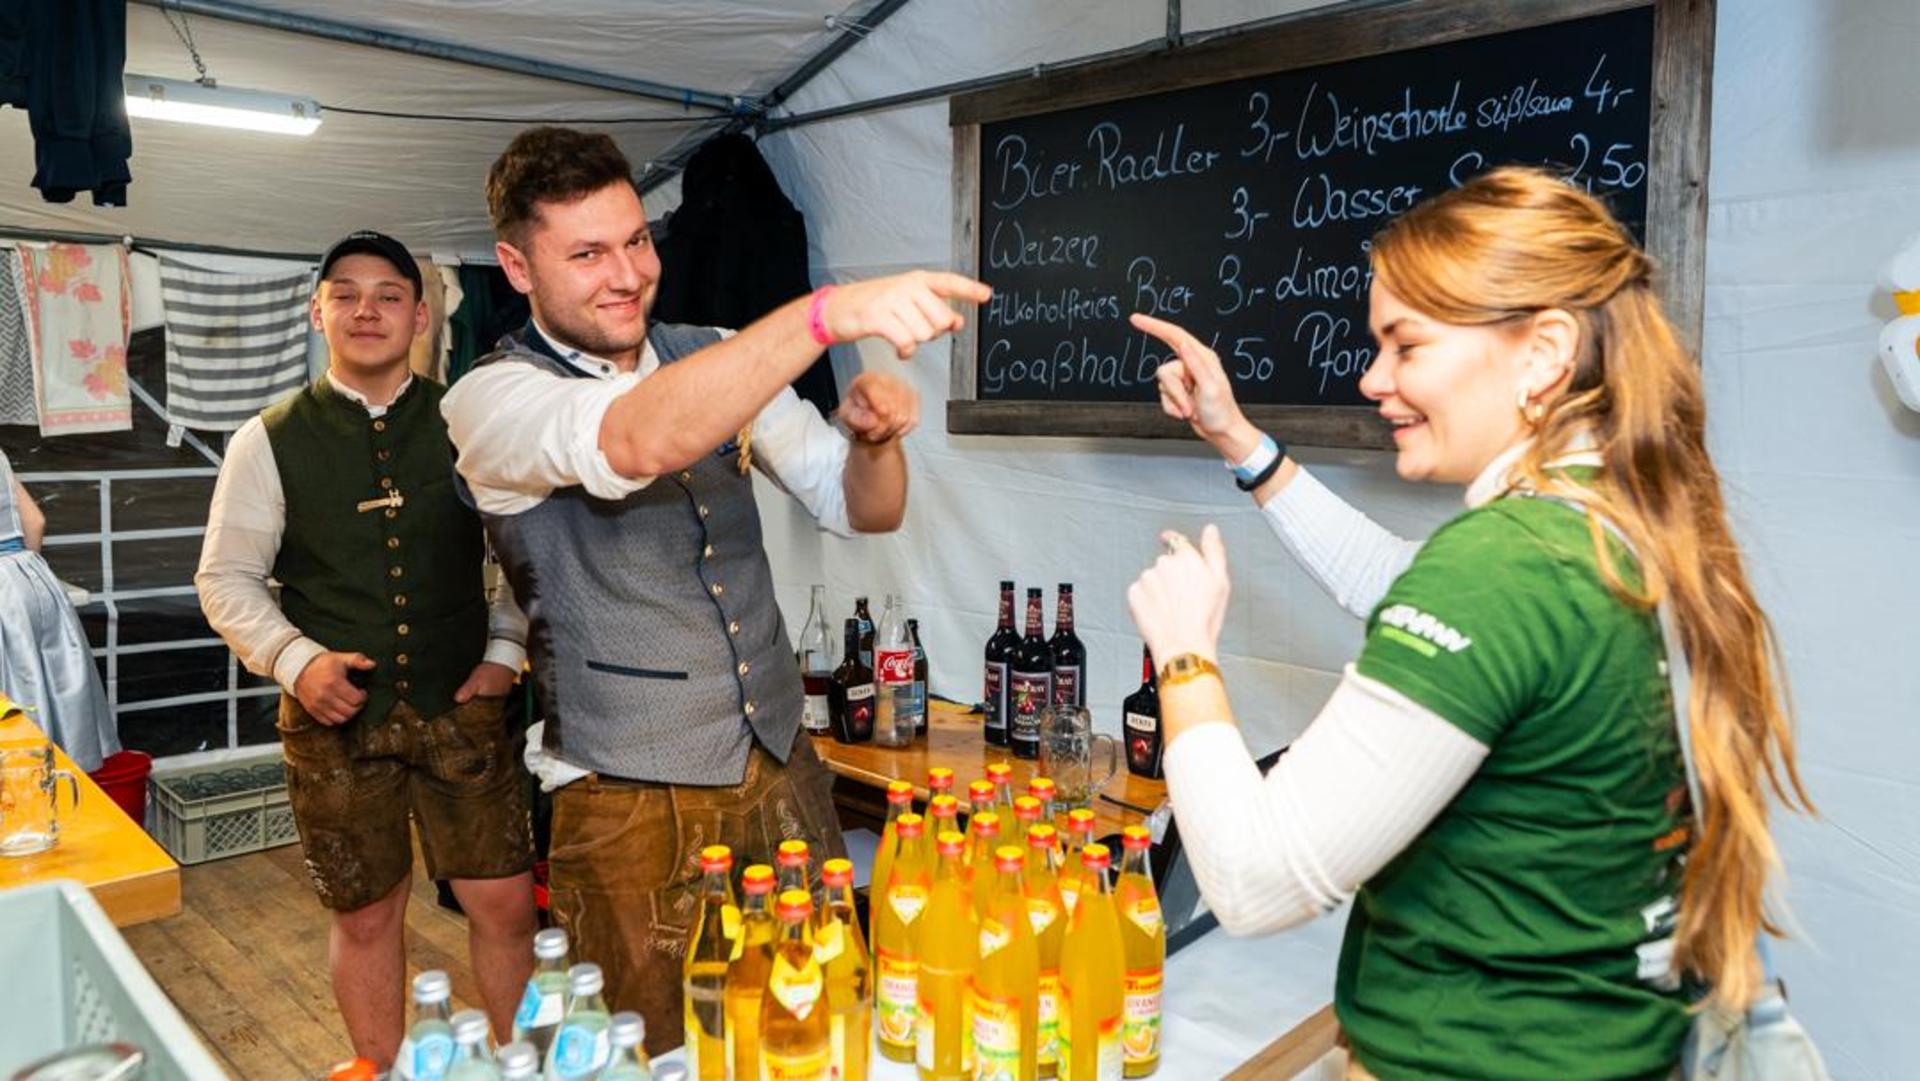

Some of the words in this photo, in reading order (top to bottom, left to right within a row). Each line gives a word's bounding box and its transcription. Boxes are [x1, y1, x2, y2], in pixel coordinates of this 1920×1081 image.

[1086, 122, 1220, 190] Radler
[1295, 80, 1468, 160] Weinschorle
[989, 220, 1100, 269] Weizen
[1292, 173, 1423, 229] Wasser
[1561, 132, 1646, 199] 2,50
[987, 286, 1121, 331] Alkoholfreies
[1127, 255, 1196, 315] Bier
[983, 332, 1177, 393] Goaßhalb
[1293, 311, 1371, 395] Pfan
